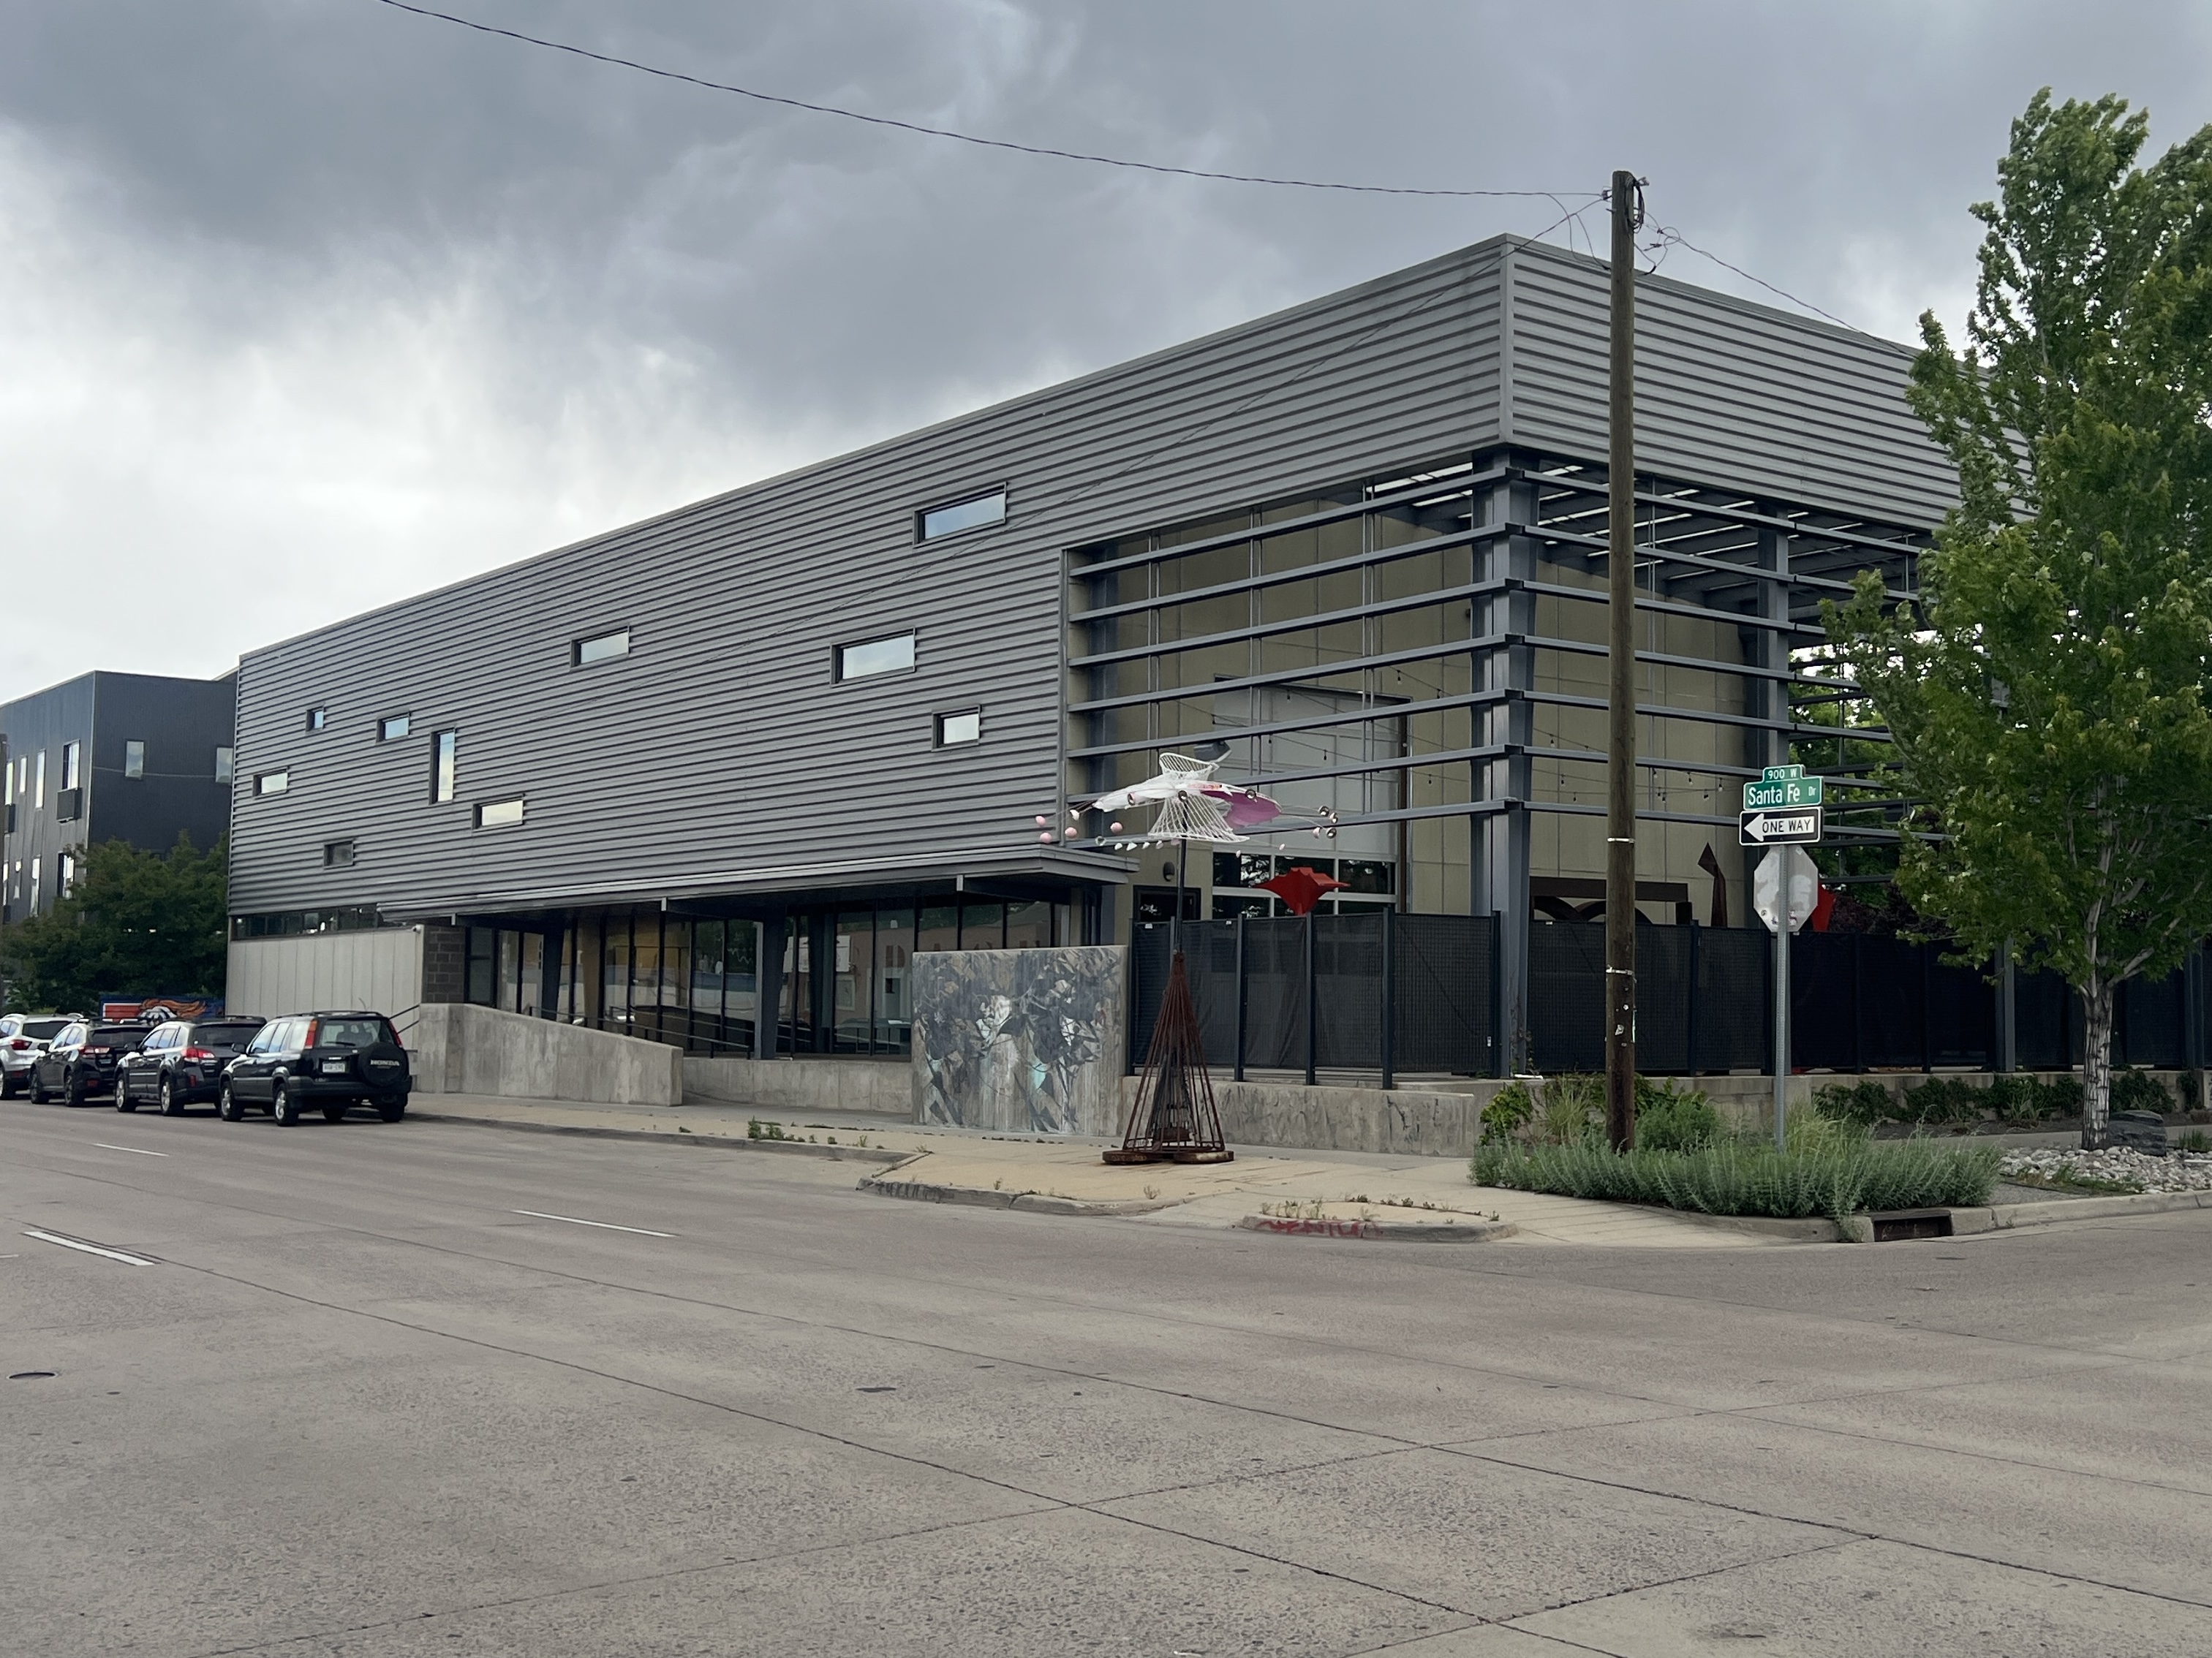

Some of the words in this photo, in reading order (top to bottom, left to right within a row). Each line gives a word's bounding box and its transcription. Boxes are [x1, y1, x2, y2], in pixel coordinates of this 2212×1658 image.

[1768, 769, 1785, 779] 900
[1790, 768, 1797, 778] W
[1748, 786, 1783, 806] Santa
[1787, 784, 1800, 803] Fe
[1808, 786, 1816, 796] Dr
[1762, 821, 1784, 833] ONE
[1789, 819, 1811, 832] WAY
